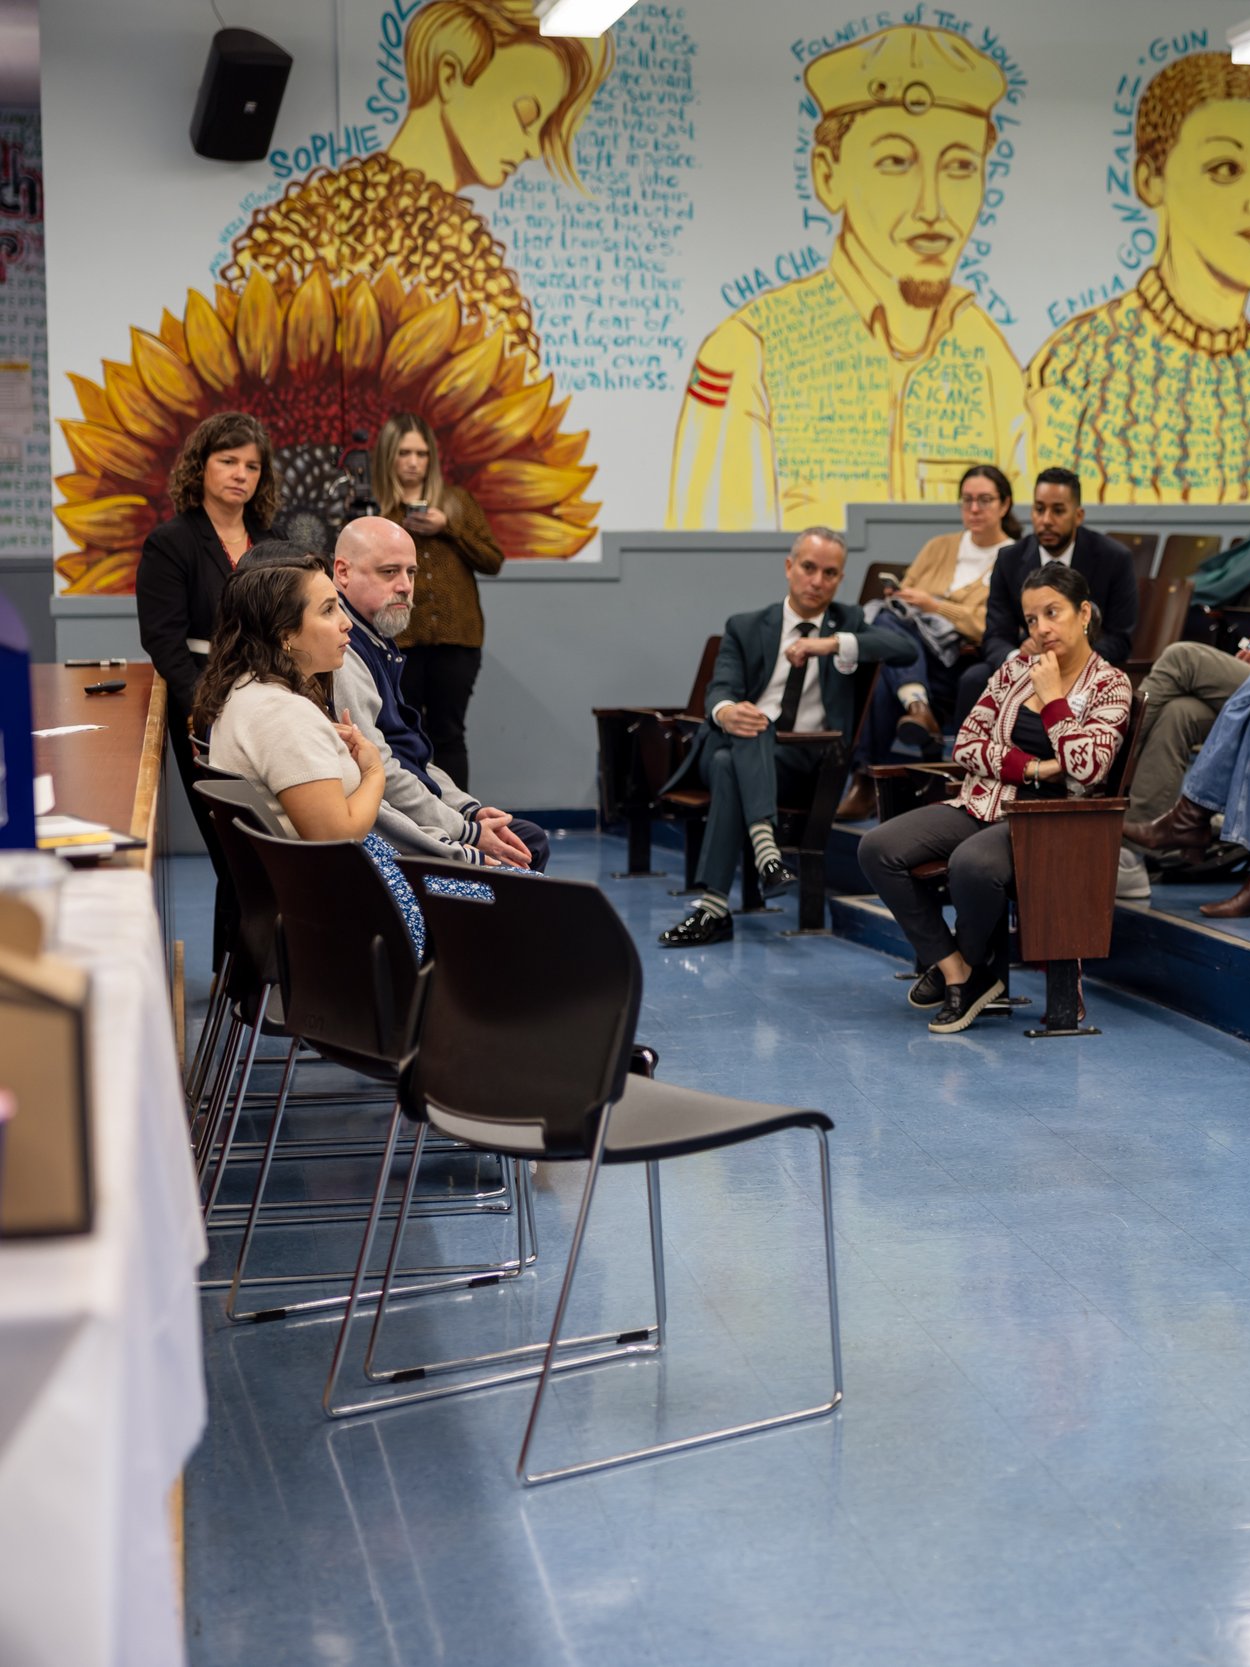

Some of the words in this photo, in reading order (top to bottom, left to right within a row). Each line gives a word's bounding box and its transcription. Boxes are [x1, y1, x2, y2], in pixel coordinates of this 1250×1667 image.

[1147, 28, 1209, 62] GUN
[269, 124, 382, 179] SOPHIE
[720, 265, 770, 308] CHA
[773, 244, 826, 282] CHA
